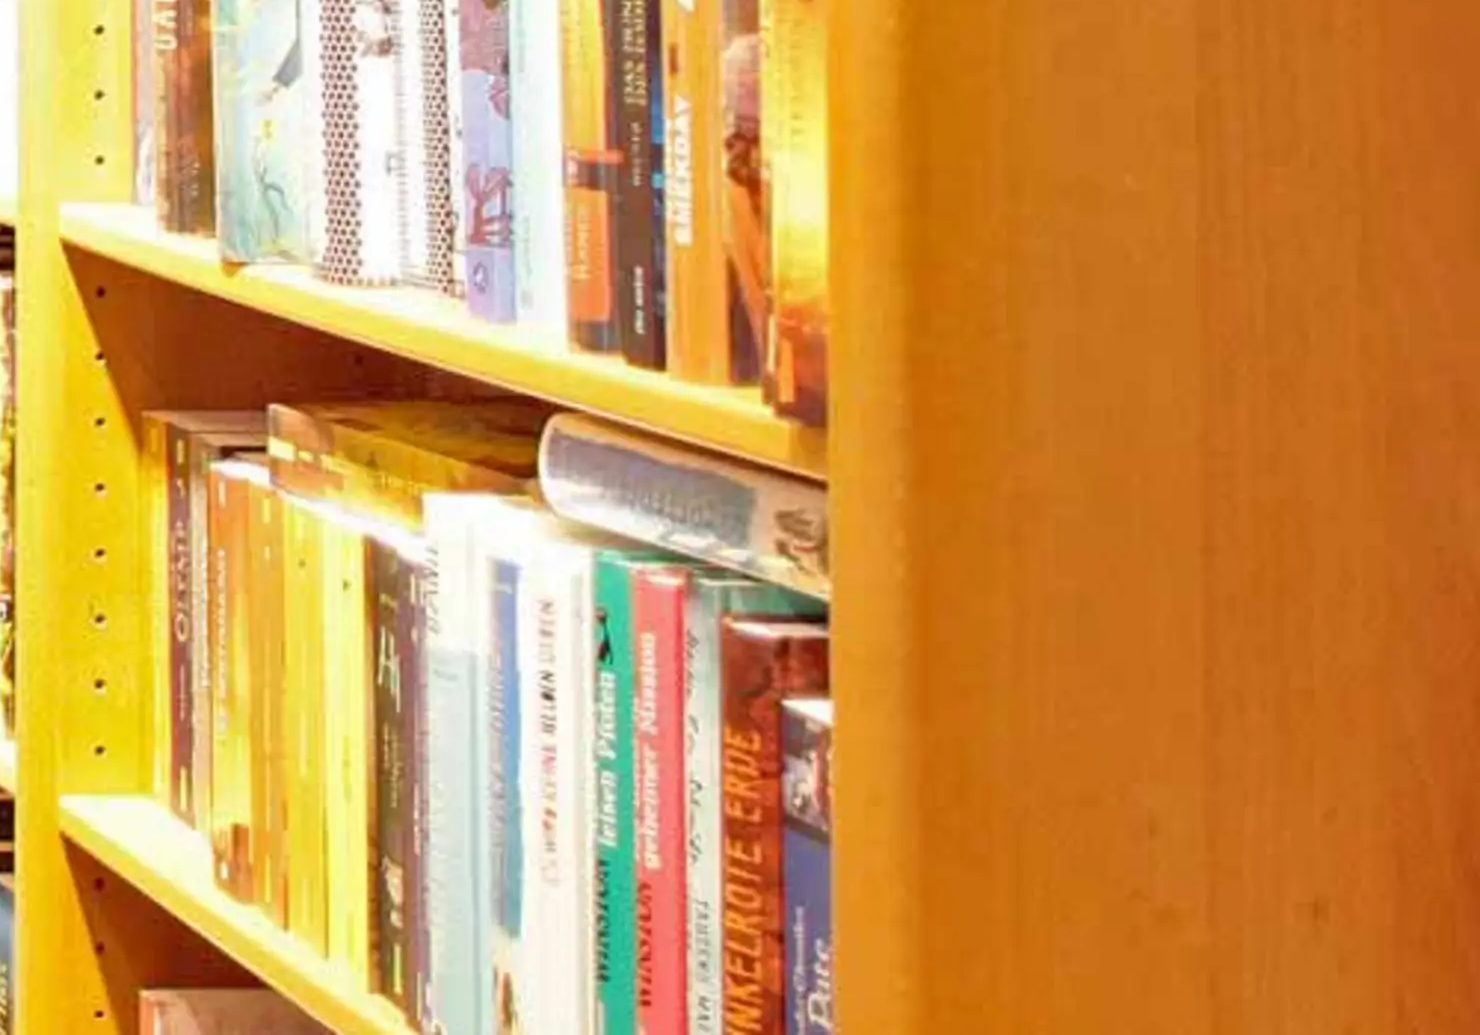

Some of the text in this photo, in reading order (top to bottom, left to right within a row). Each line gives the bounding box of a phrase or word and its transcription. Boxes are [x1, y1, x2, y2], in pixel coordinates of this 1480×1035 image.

[636, 631, 659, 737] Mission
[596, 770, 619, 849] leisen
[638, 742, 663, 871] geheimer
[723, 725, 764, 1035] NKELROTE ERDE
